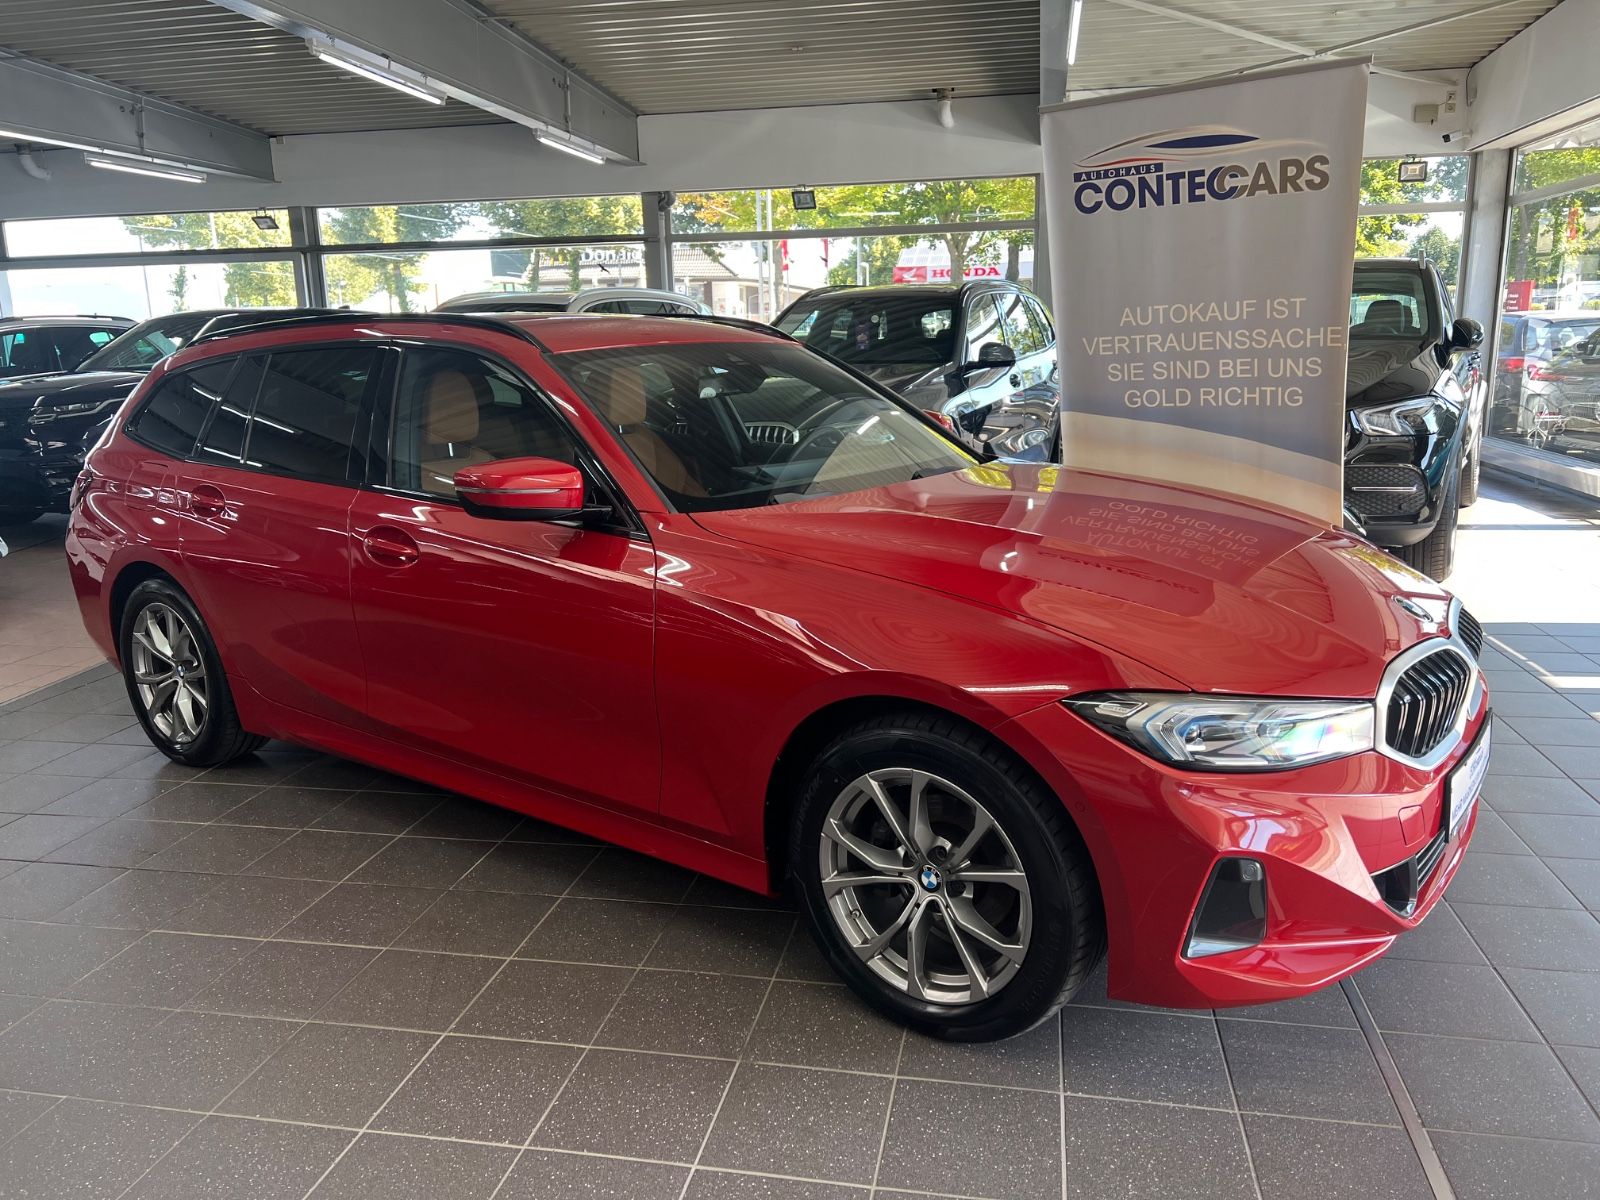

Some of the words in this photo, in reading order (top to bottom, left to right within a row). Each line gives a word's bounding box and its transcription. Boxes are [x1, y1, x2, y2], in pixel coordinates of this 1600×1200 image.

[1080, 164, 1157, 181] AUTOHAUS
[1120, 300, 1257, 326] AUTOKAUF
[1266, 298, 1307, 320] IST
[1107, 362, 1145, 382] SIE
[1152, 360, 1210, 380] SIND
[1218, 358, 1259, 378] BEI
[1267, 357, 1323, 378] UNS
[1124, 388, 1192, 408] GOLD
[1200, 387, 1304, 407] RICHTIG
